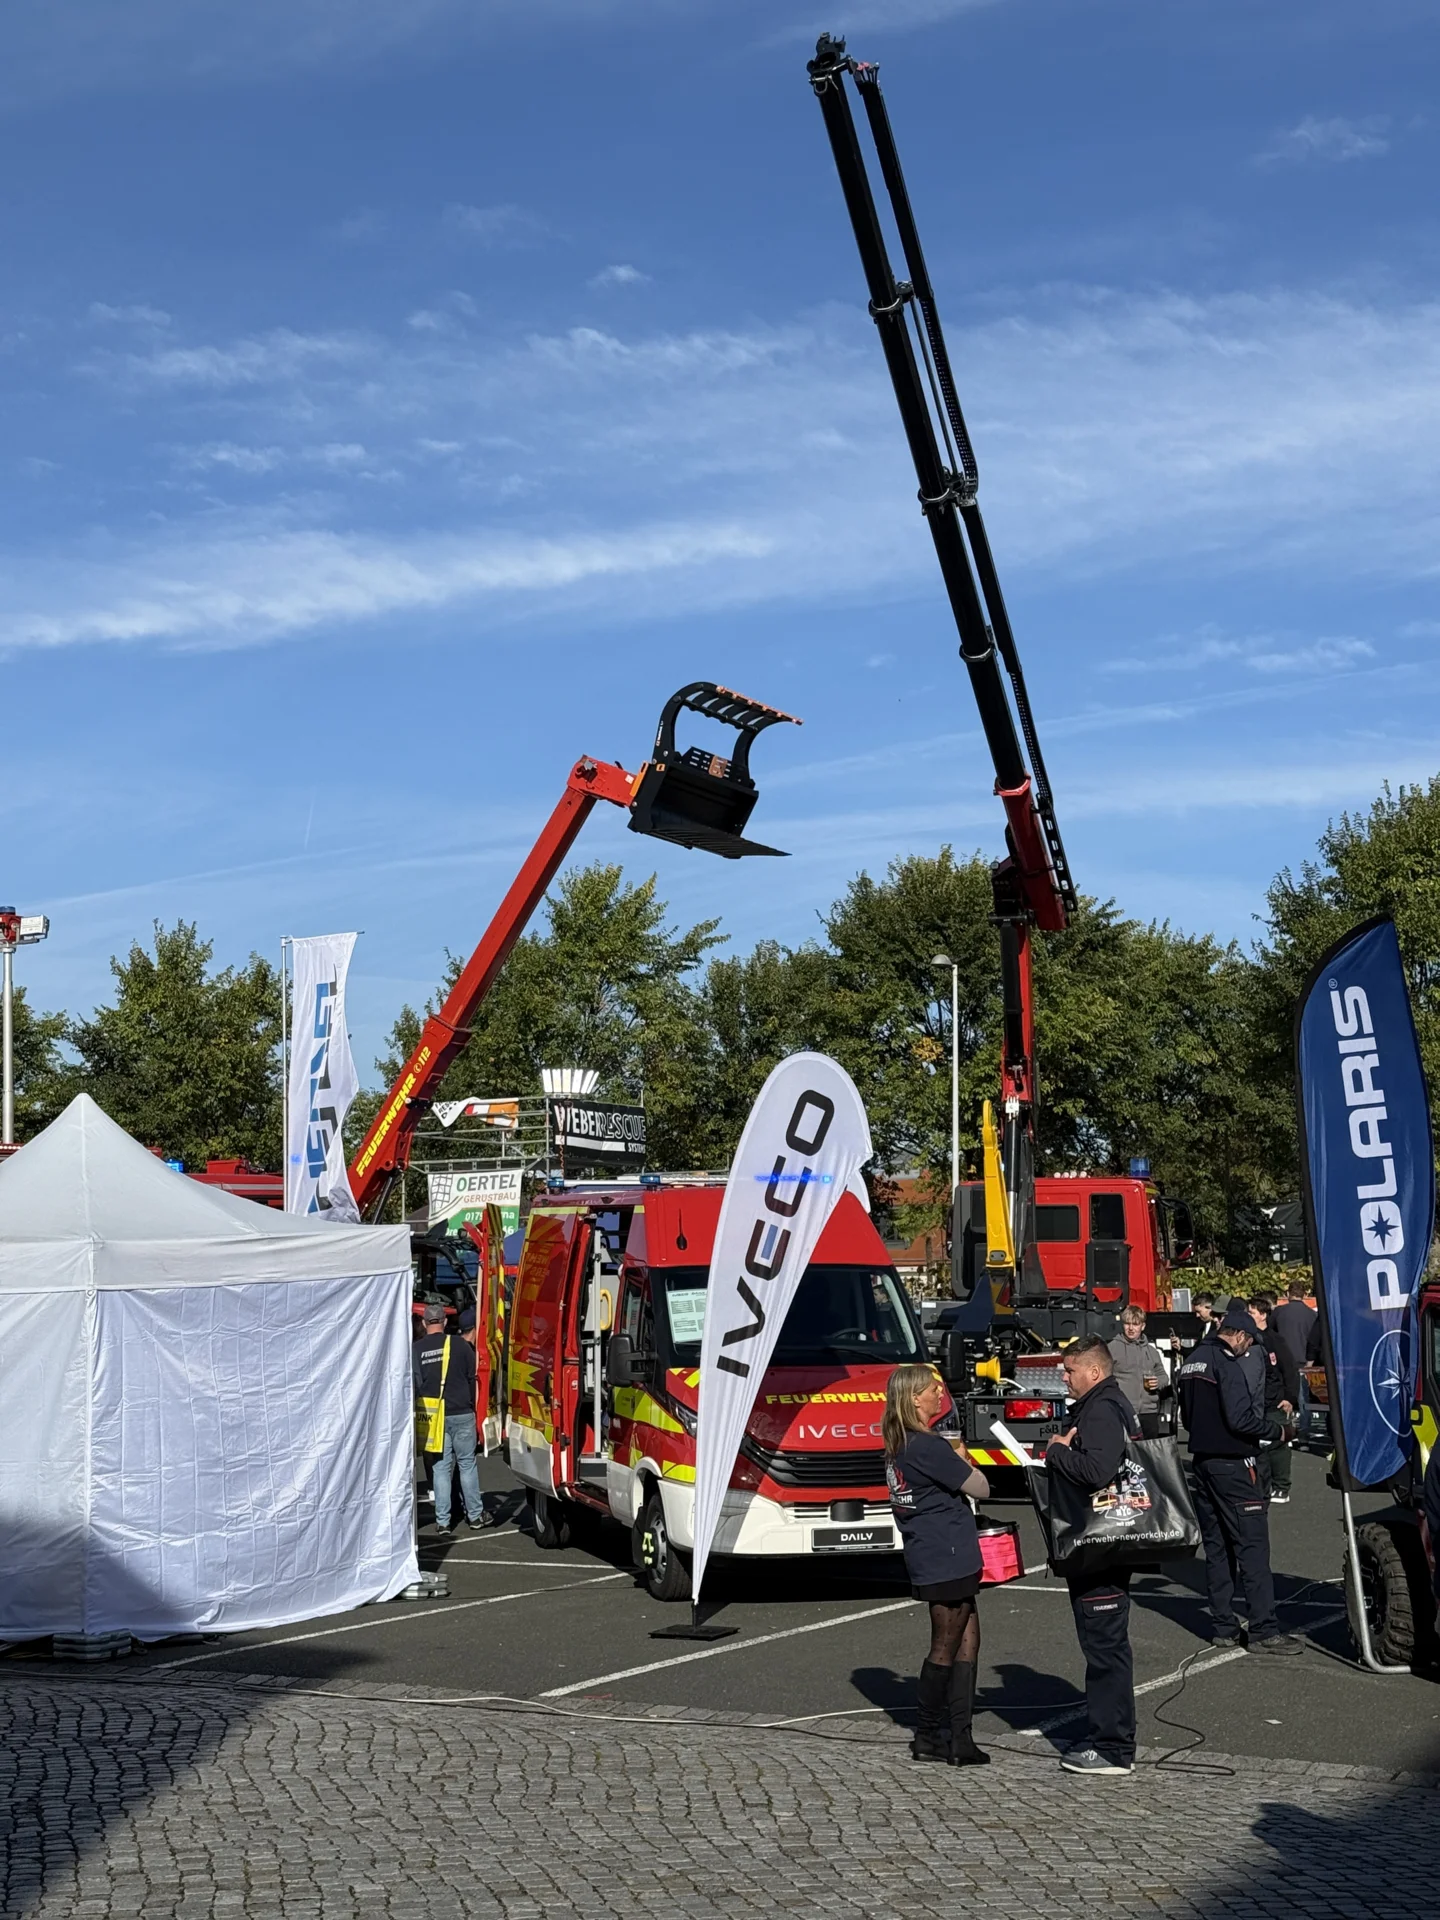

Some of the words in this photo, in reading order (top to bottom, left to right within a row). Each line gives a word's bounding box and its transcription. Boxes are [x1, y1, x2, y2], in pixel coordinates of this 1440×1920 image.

[356, 1073, 416, 1178] FEUERWEHR
[418, 1046, 431, 1066] 112
[1330, 985, 1410, 1311] POLARIS
[456, 1174, 517, 1192] OERTEL
[716, 1089, 835, 1379] IVECO
[765, 1392, 887, 1405] FEUERWEH
[1040, 1424, 1059, 1437] F&B
[840, 1532, 873, 1542] DAILY
[1073, 1529, 1181, 1547] feuerwehr-newyorkcity.de
